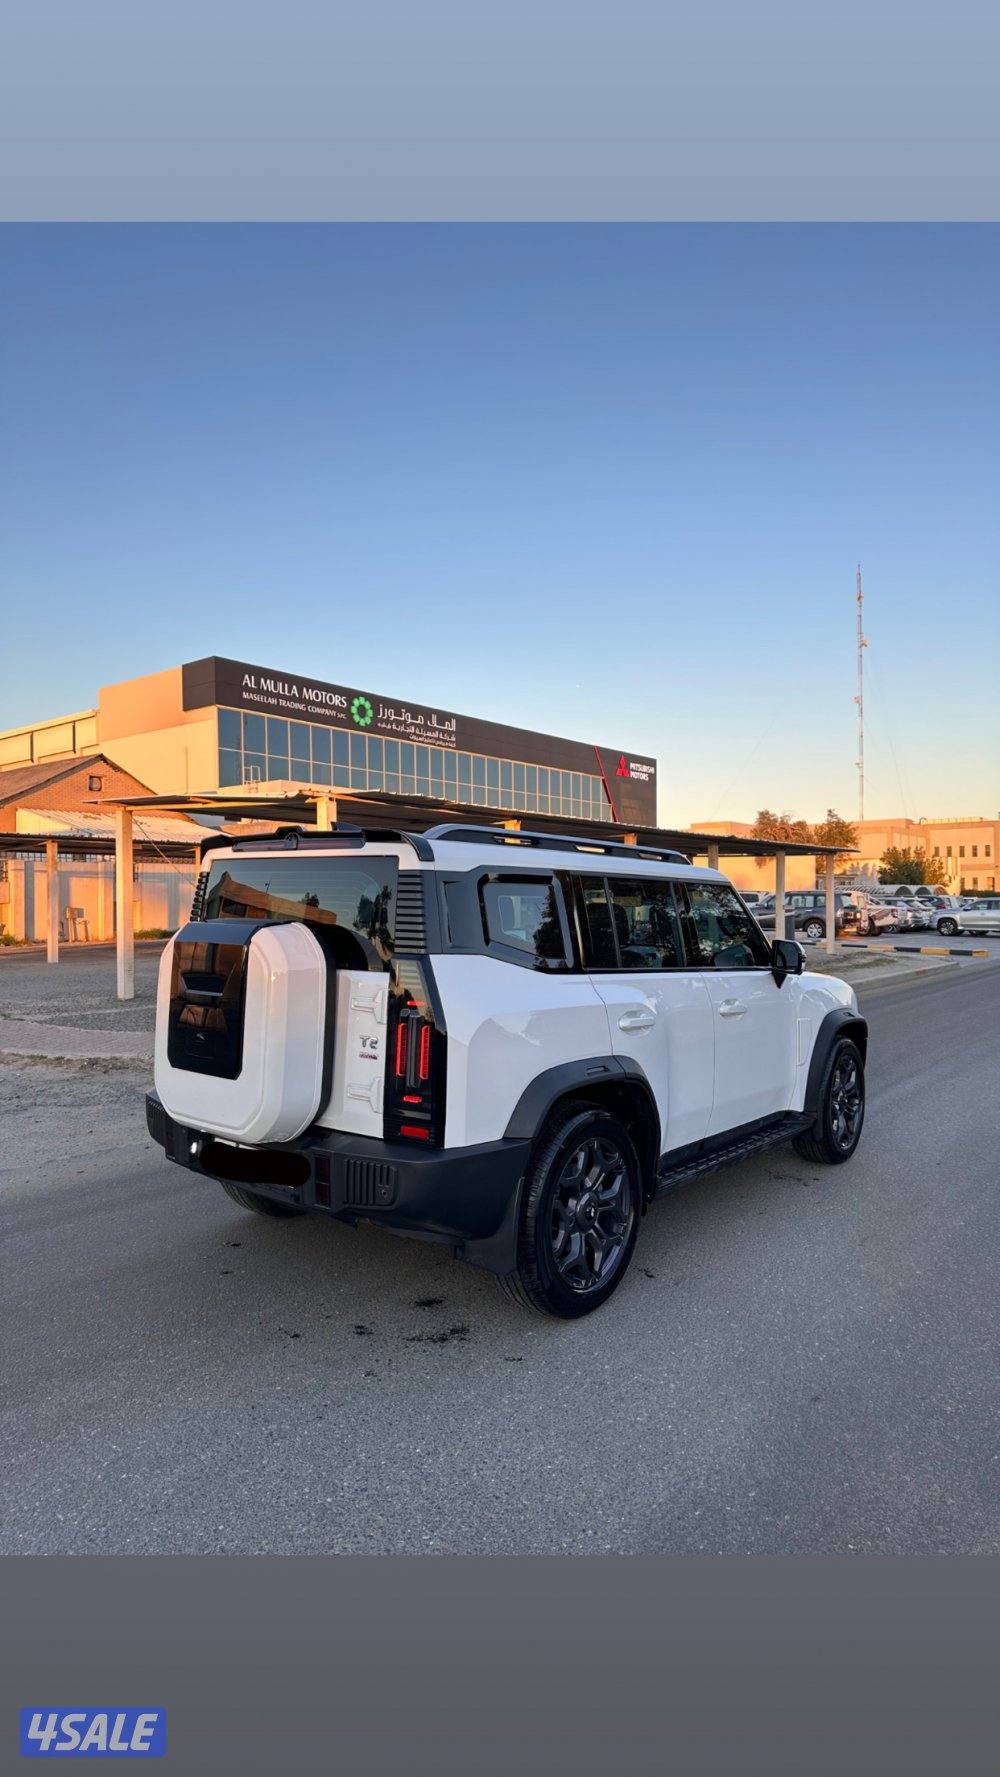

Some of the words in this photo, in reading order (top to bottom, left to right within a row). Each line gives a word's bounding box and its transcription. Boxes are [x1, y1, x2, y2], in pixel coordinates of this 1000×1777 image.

[242, 674, 257, 689] AL
[260, 677, 299, 698] MULLA
[302, 687, 348, 708] MOTORS
[242, 691, 277, 705] MASEELAH
[279, 698, 306, 711] TRADING
[308, 705, 336, 717] COMPANY
[377, 704, 424, 724] موتورز
[392, 722, 415, 733] التجارية
[440, 731, 456, 741] شركة
[630, 762, 655, 775] MITSUBISHI
[630, 771, 649, 781] MOTORS
